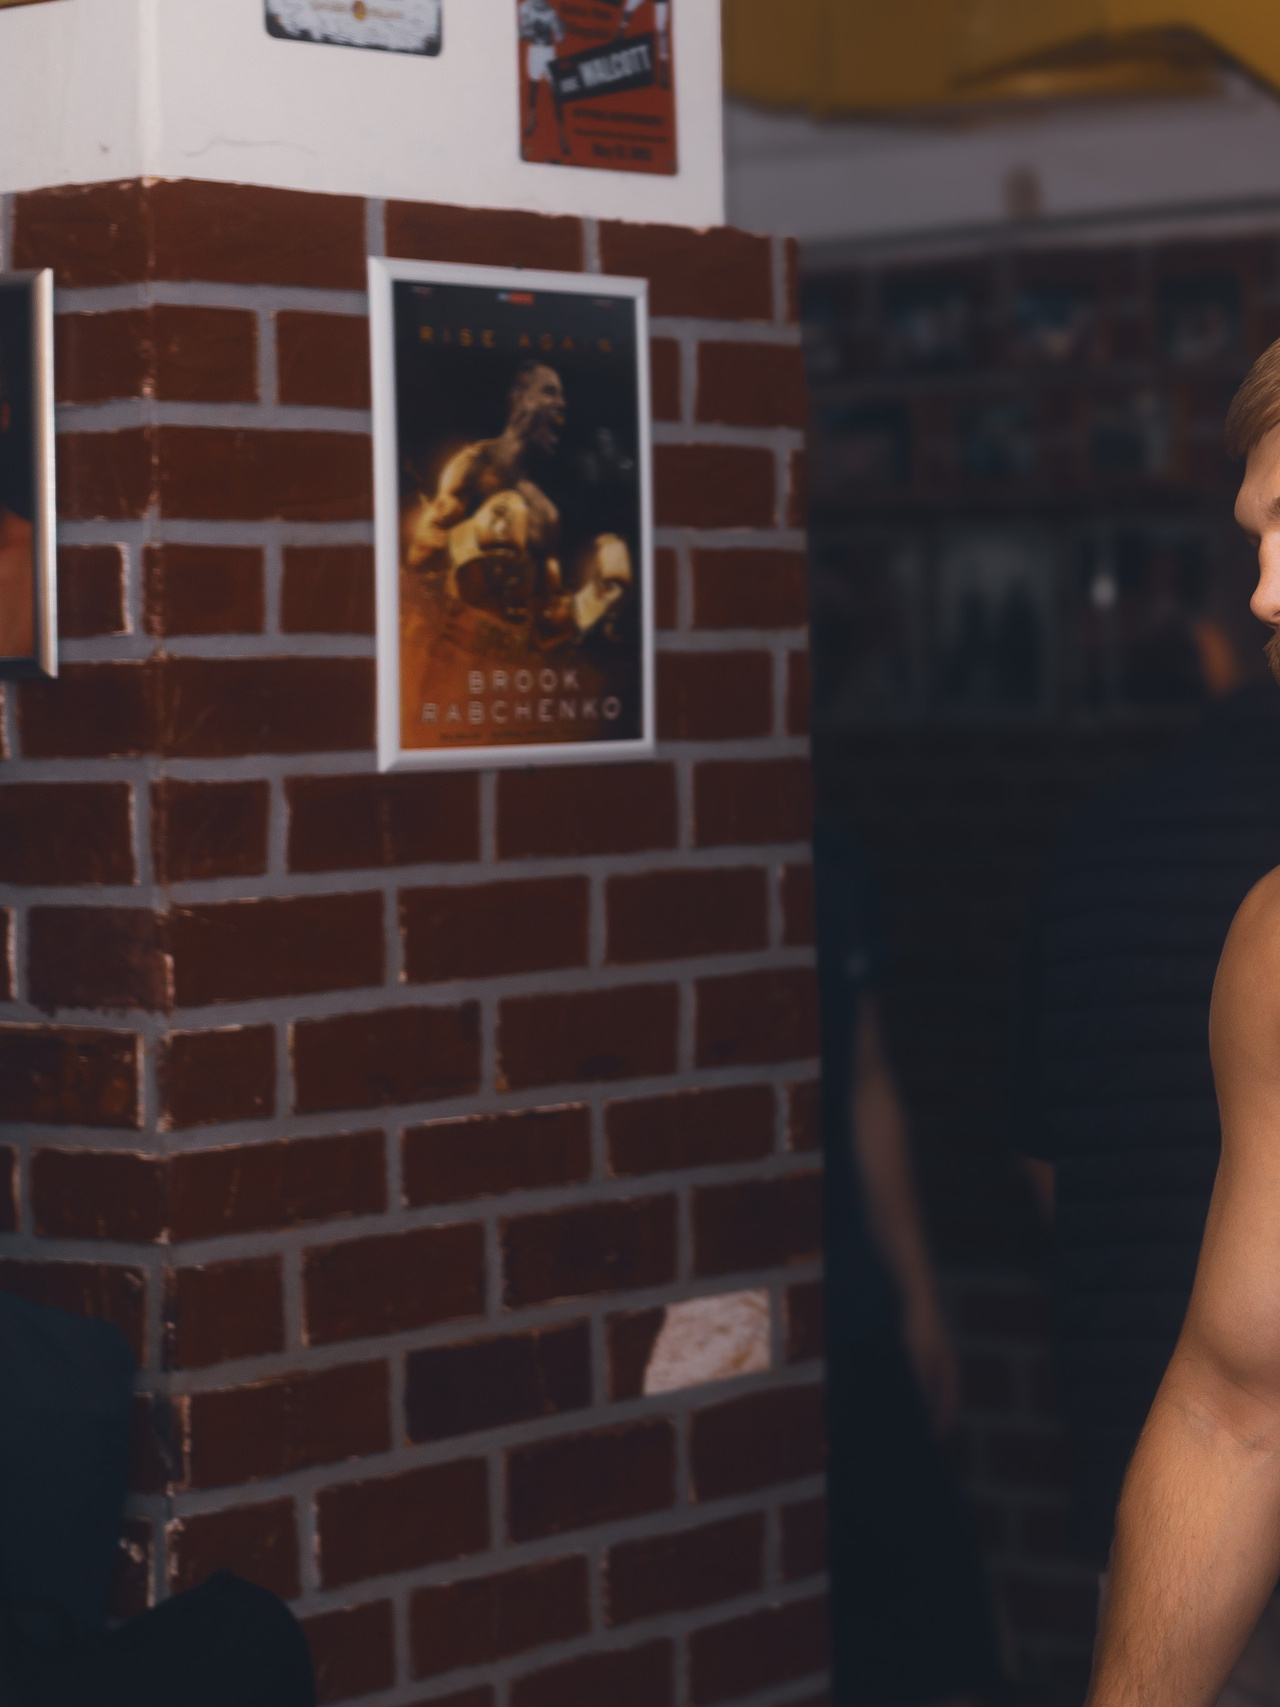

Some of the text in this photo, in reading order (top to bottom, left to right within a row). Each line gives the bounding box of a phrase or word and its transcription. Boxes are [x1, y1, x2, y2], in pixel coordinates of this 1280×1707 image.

[578, 44, 651, 88] WALCOTT
[418, 325, 496, 348] RISE
[468, 669, 580, 695] BROOK
[421, 696, 622, 726] RABCHENKO
